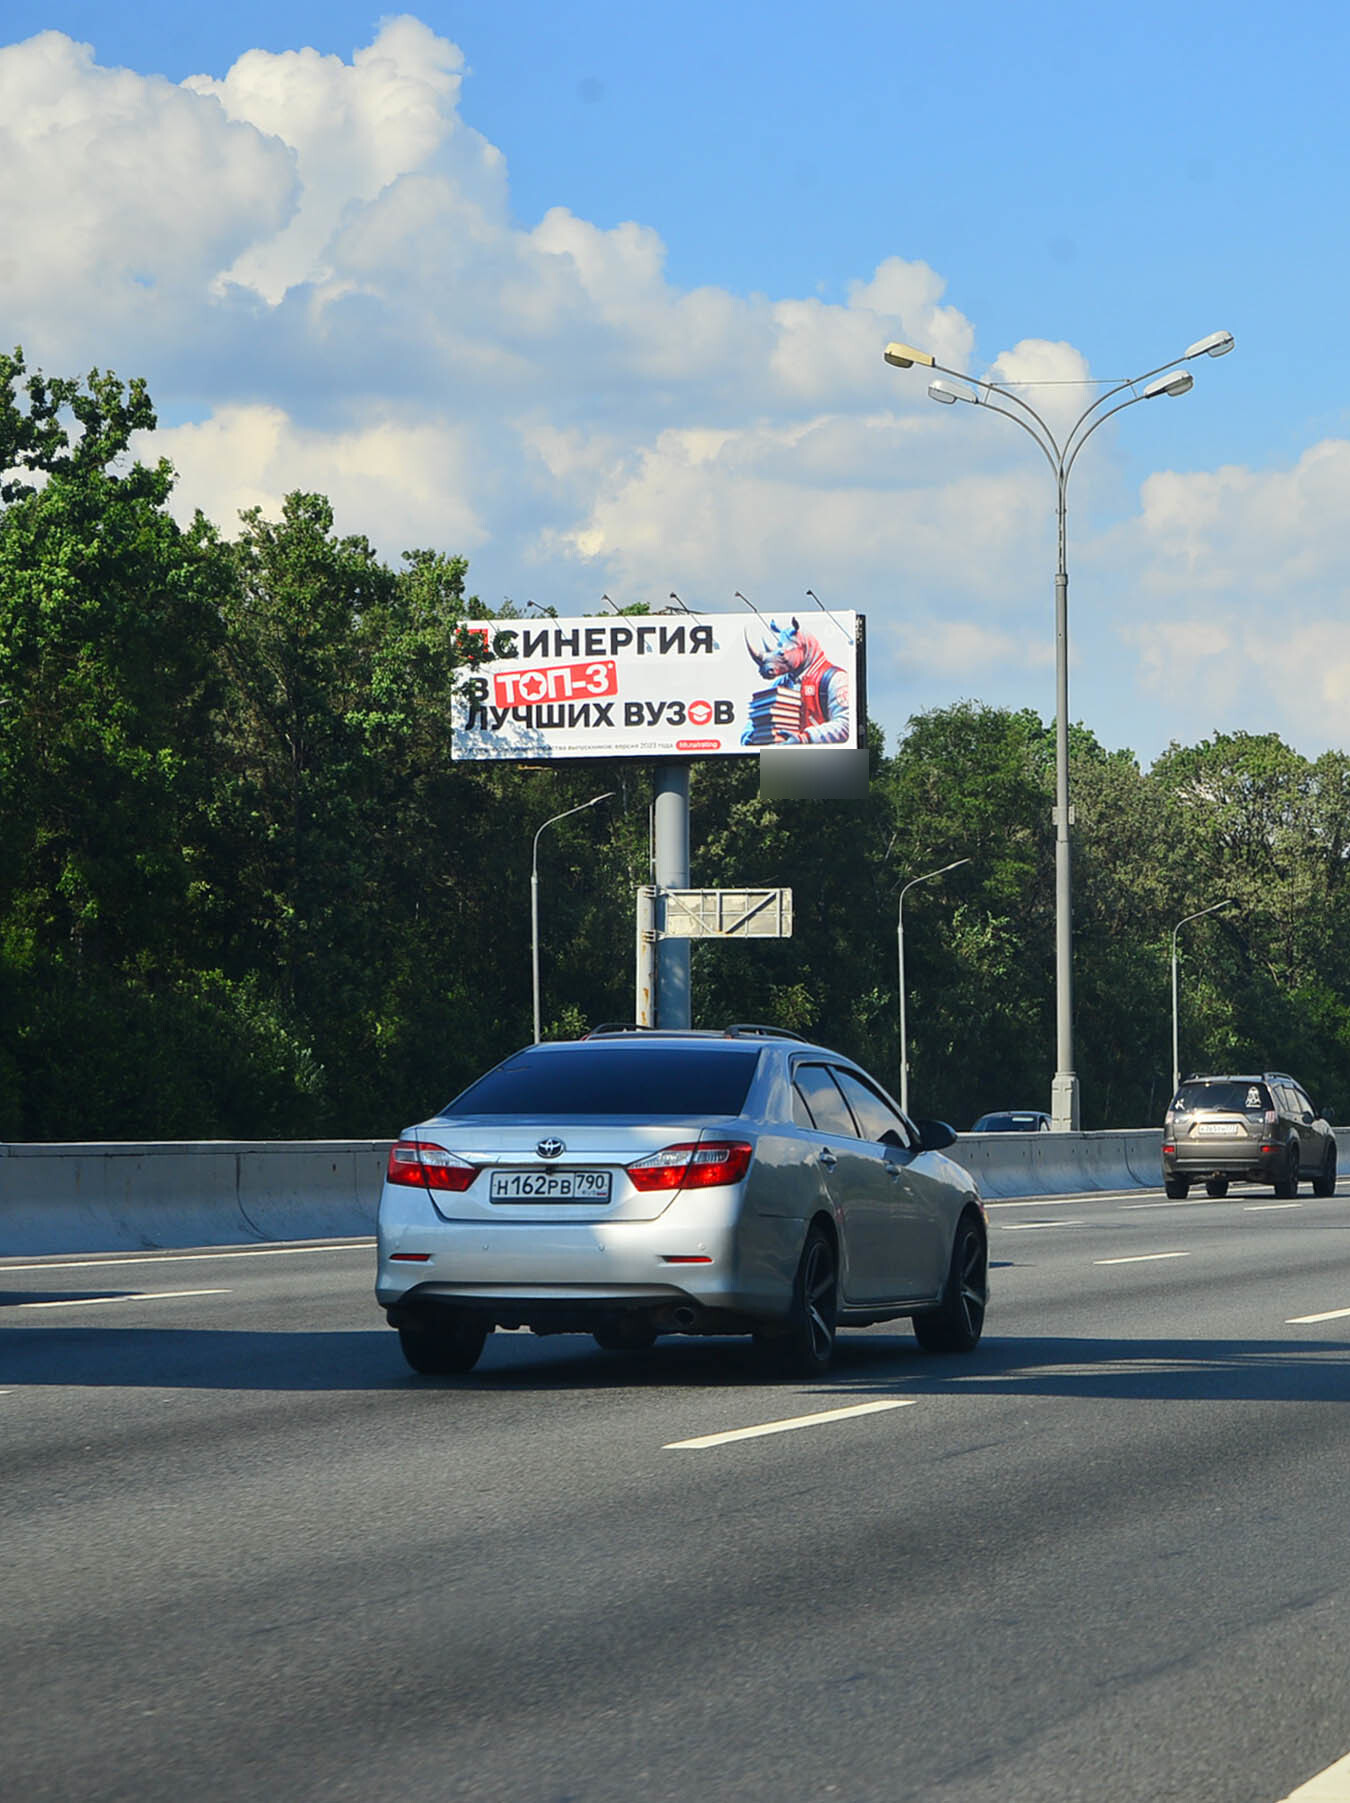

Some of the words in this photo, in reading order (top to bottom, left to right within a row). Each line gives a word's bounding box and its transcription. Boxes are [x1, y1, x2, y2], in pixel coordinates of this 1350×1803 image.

[493, 625, 713, 659] СИНЕРГИЯ
[465, 702, 615, 731] ЛУЧШИХ
[624, 699, 735, 727] ВУЗОВ
[497, 1175, 571, 1195] Н162РВ
[576, 1174, 605, 1190] 790
